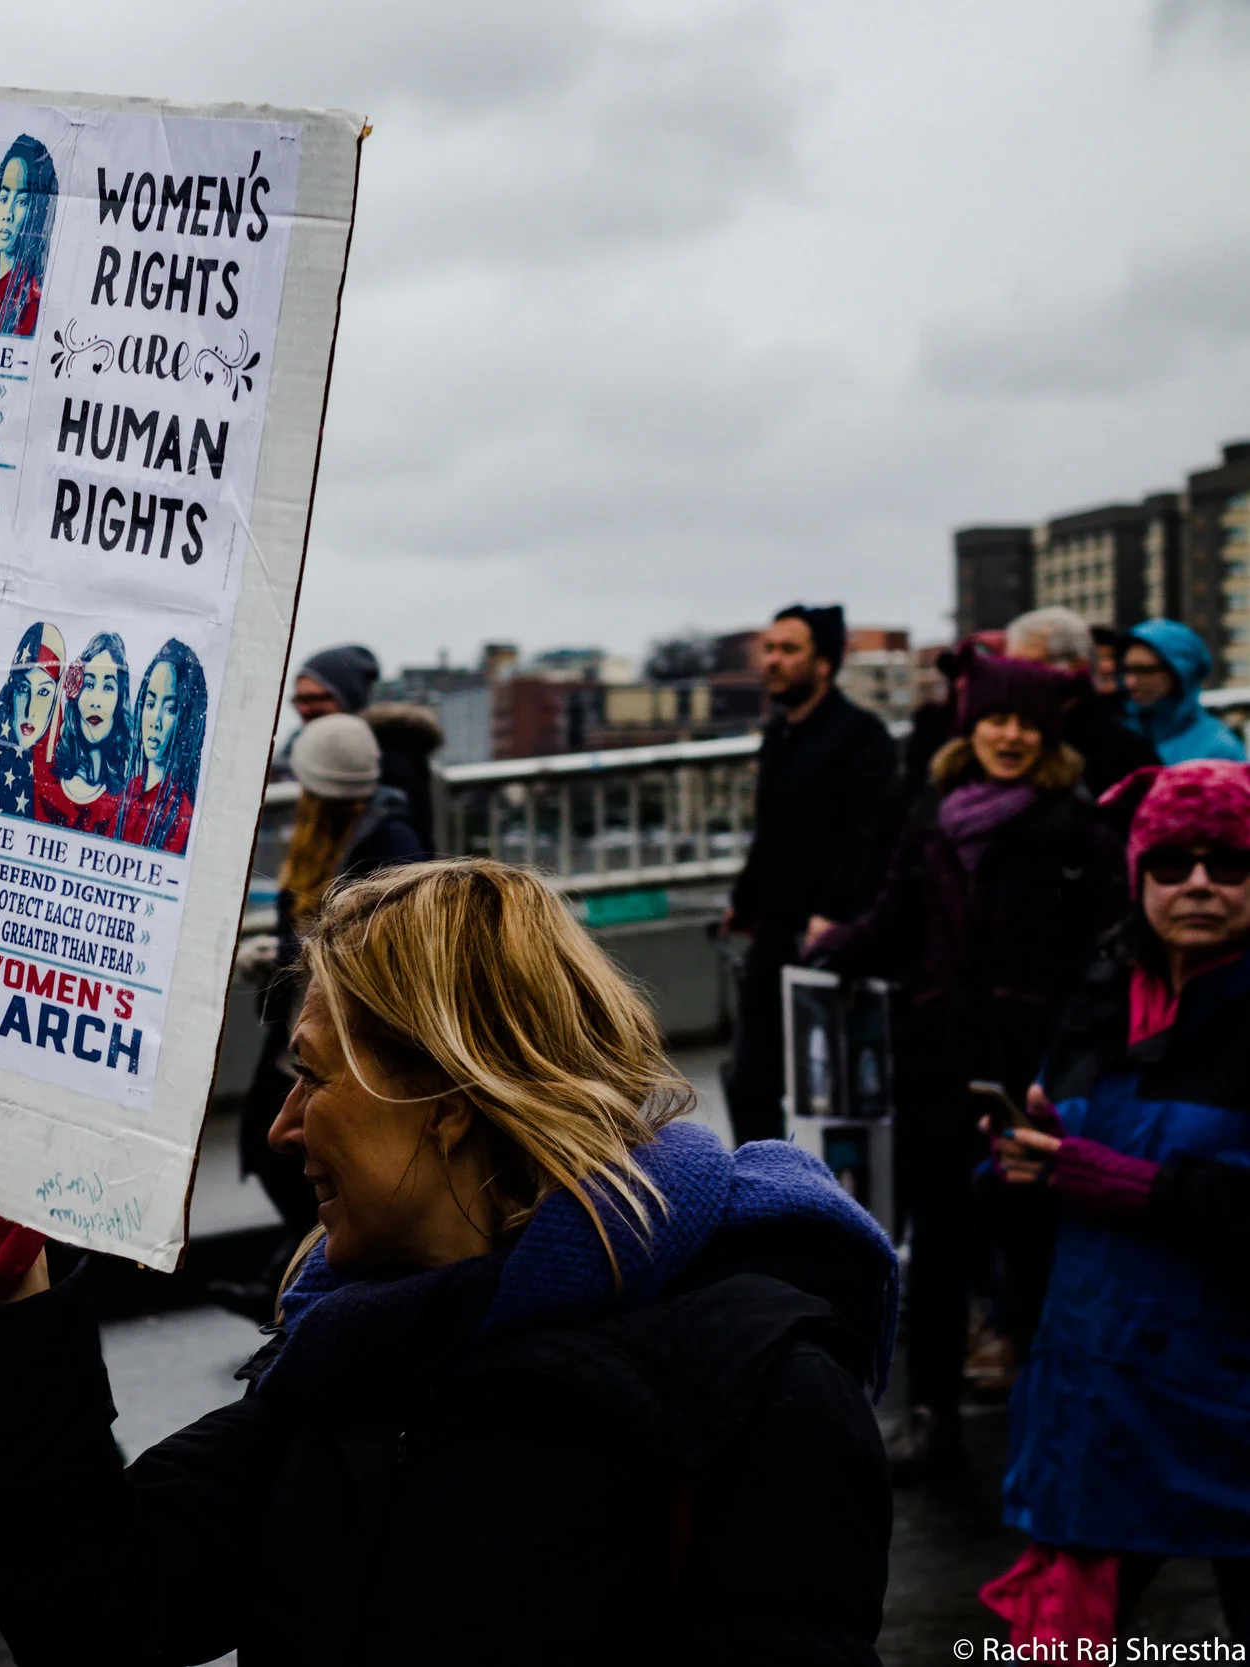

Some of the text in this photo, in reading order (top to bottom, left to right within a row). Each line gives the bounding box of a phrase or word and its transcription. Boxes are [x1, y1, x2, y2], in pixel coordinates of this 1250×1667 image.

[97, 151, 270, 242] WOMEN'S
[91, 246, 238, 320] RIGHTS
[57, 398, 229, 480] HUMAN
[50, 480, 208, 566] RIGHTS
[27, 834, 68, 862] THE
[46, 900, 83, 927] EACH
[86, 912, 135, 944] OTHER
[61, 879, 141, 914] DIGNITY
[1, 919, 60, 953] GREATER
[62, 932, 97, 961] THAN
[100, 943, 132, 975] FEAR
